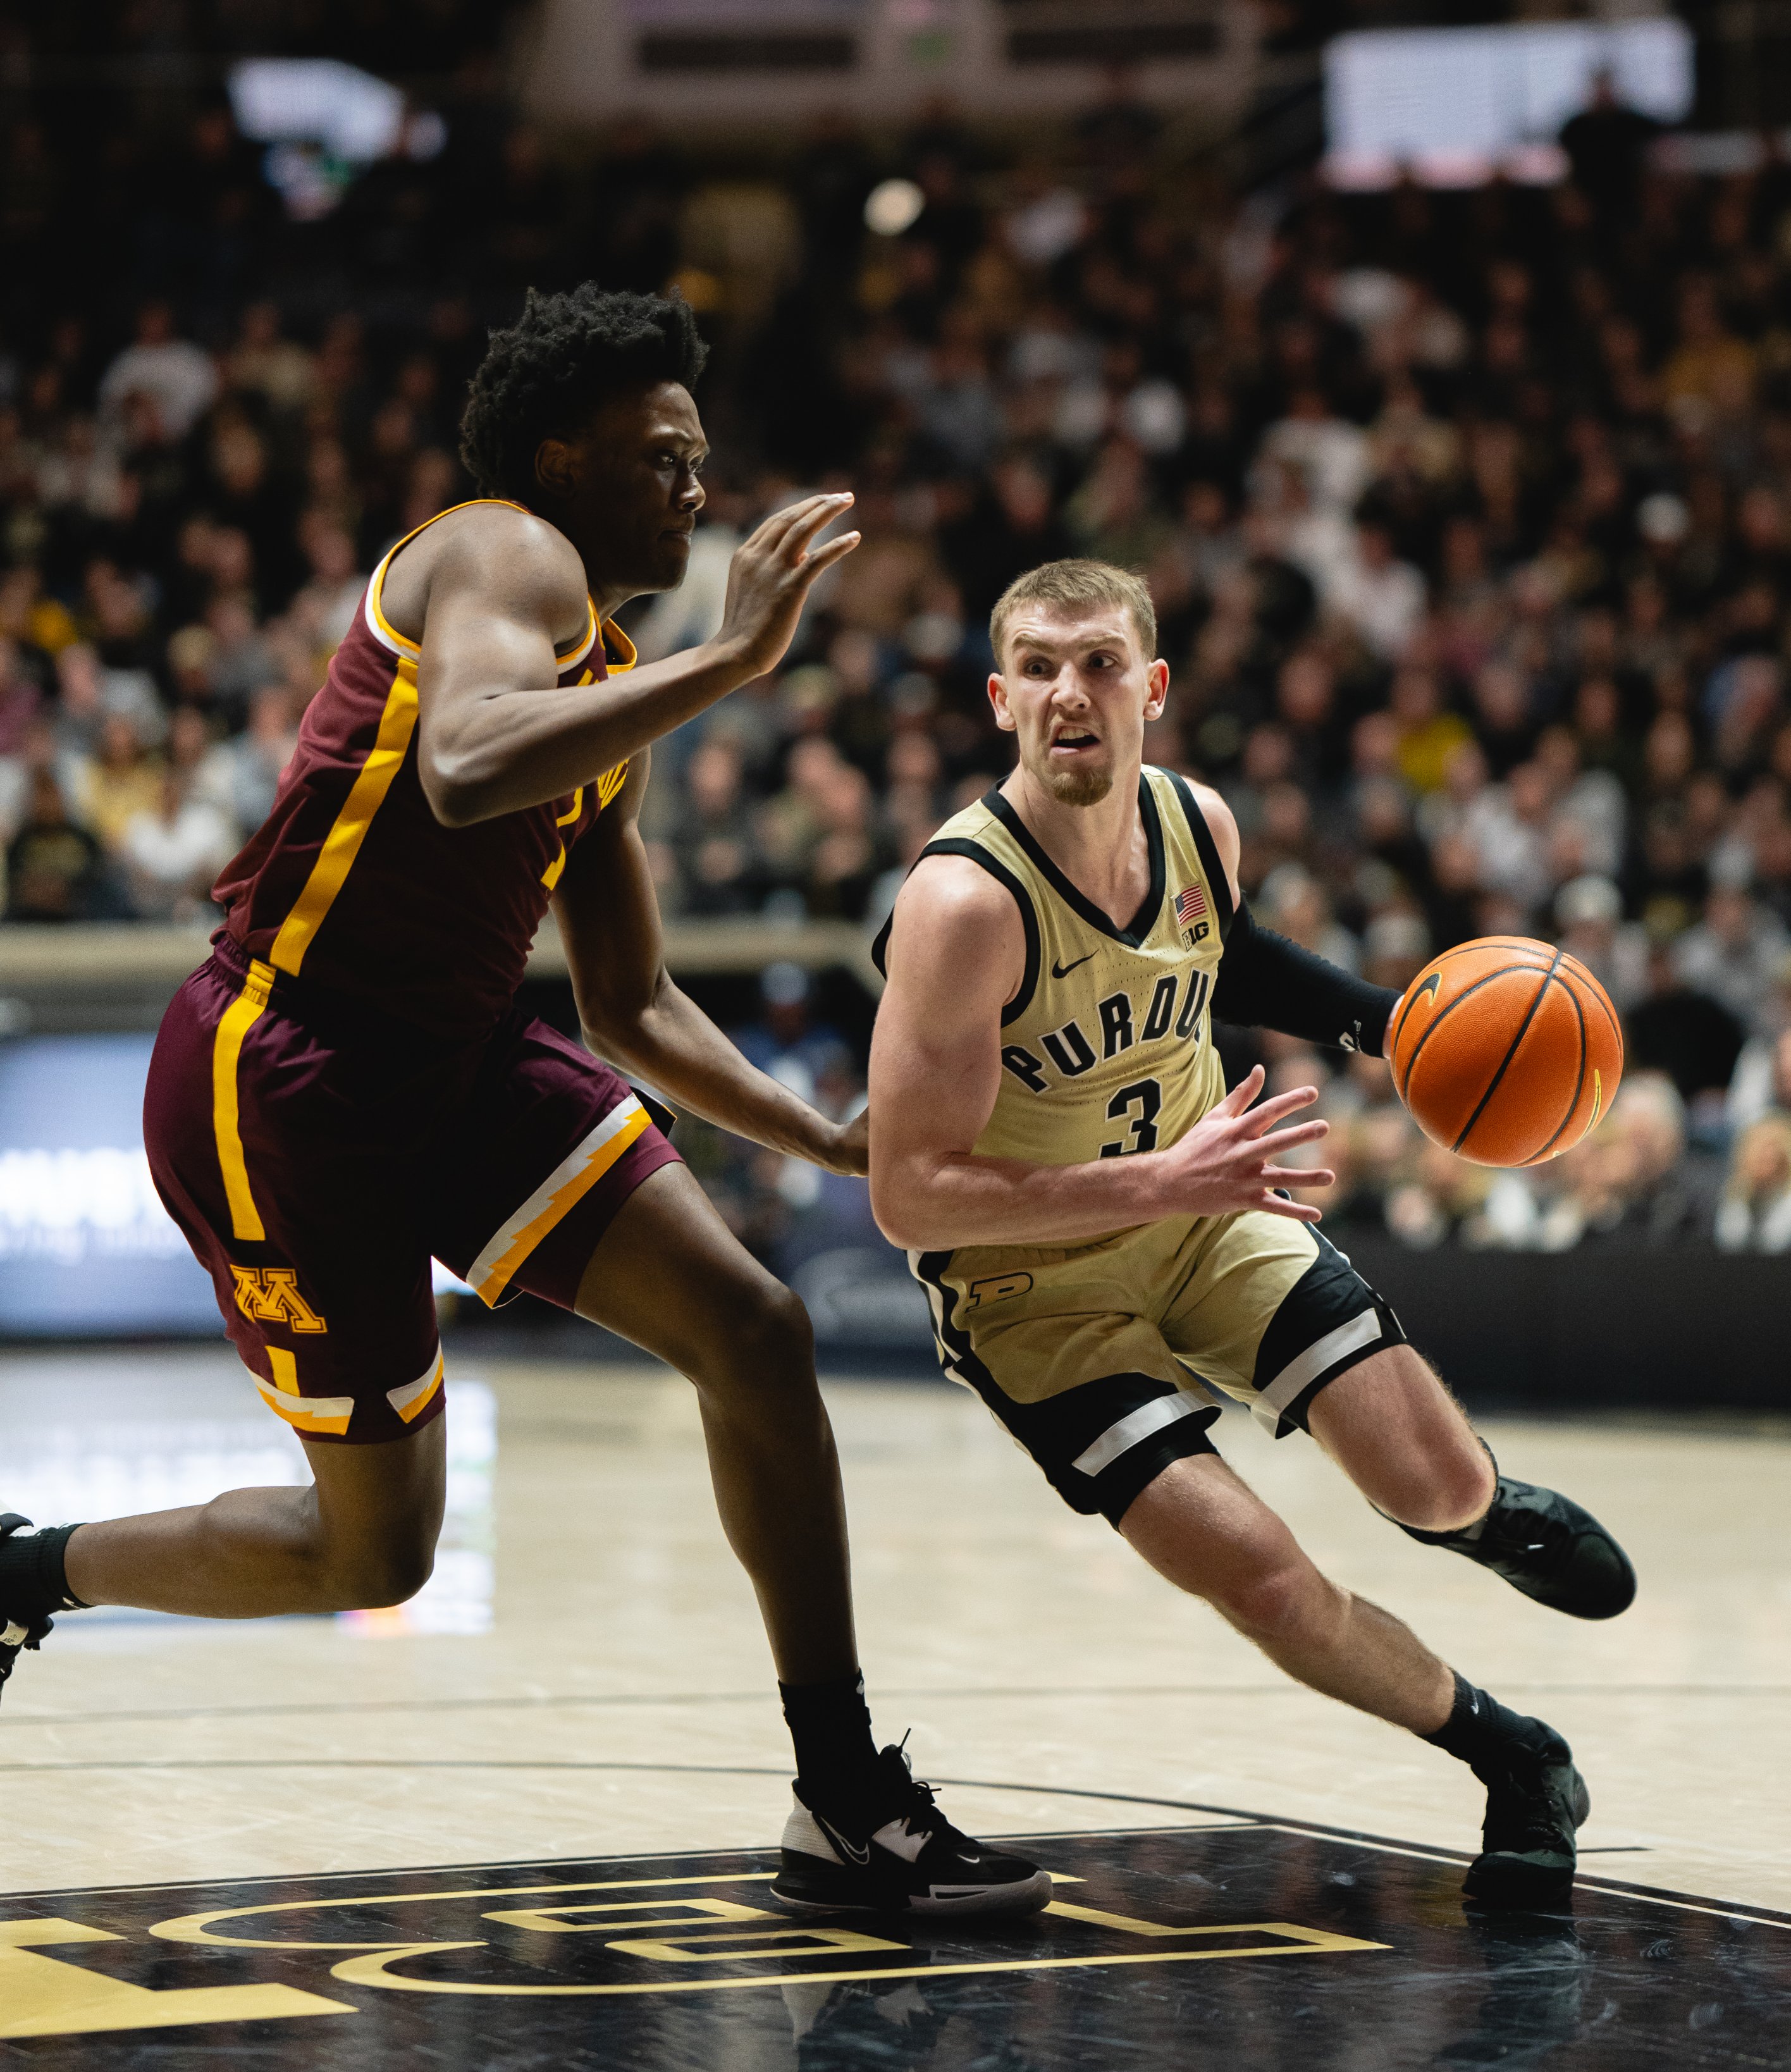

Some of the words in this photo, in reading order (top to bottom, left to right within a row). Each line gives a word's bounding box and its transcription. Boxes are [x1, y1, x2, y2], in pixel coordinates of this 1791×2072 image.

[1001, 966, 1209, 1096] PURDU
[1098, 1076, 1162, 1159] 3
[230, 1264, 328, 1333] M
[964, 1271, 1034, 1314] P
